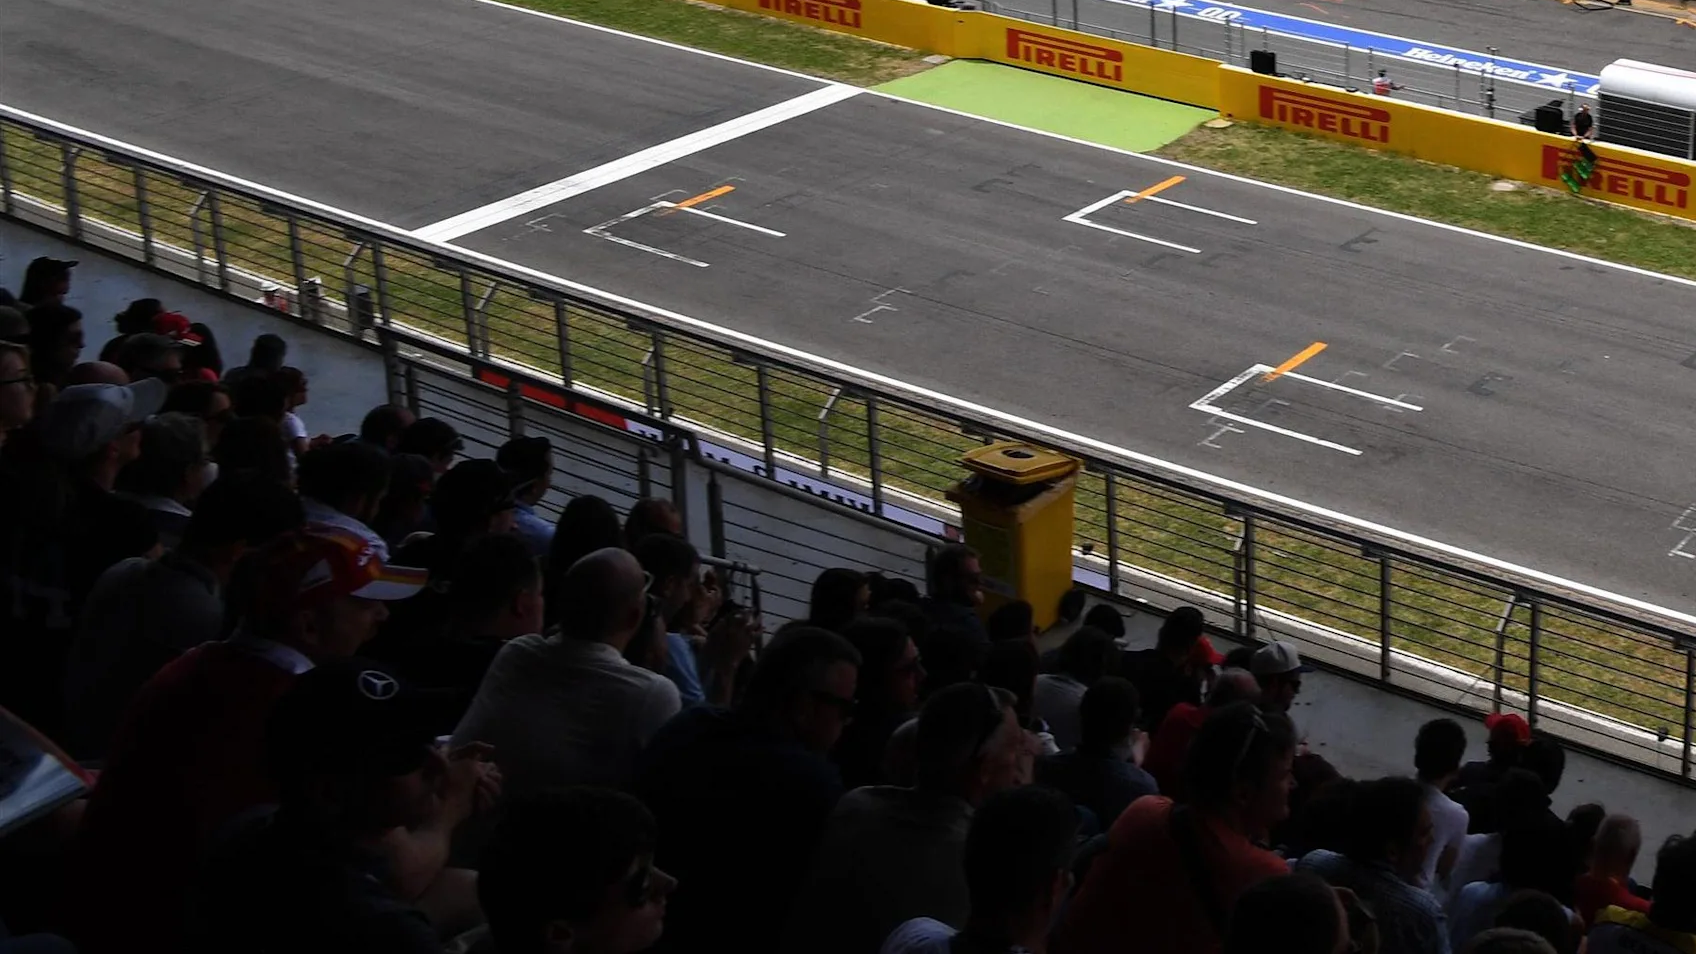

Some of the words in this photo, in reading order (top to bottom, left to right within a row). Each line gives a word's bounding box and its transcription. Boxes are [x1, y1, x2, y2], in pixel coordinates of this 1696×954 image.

[1006, 27, 1123, 82] PIRELLI
[1403, 47, 1533, 81] Heineken
[1258, 84, 1392, 144] PIRELLI
